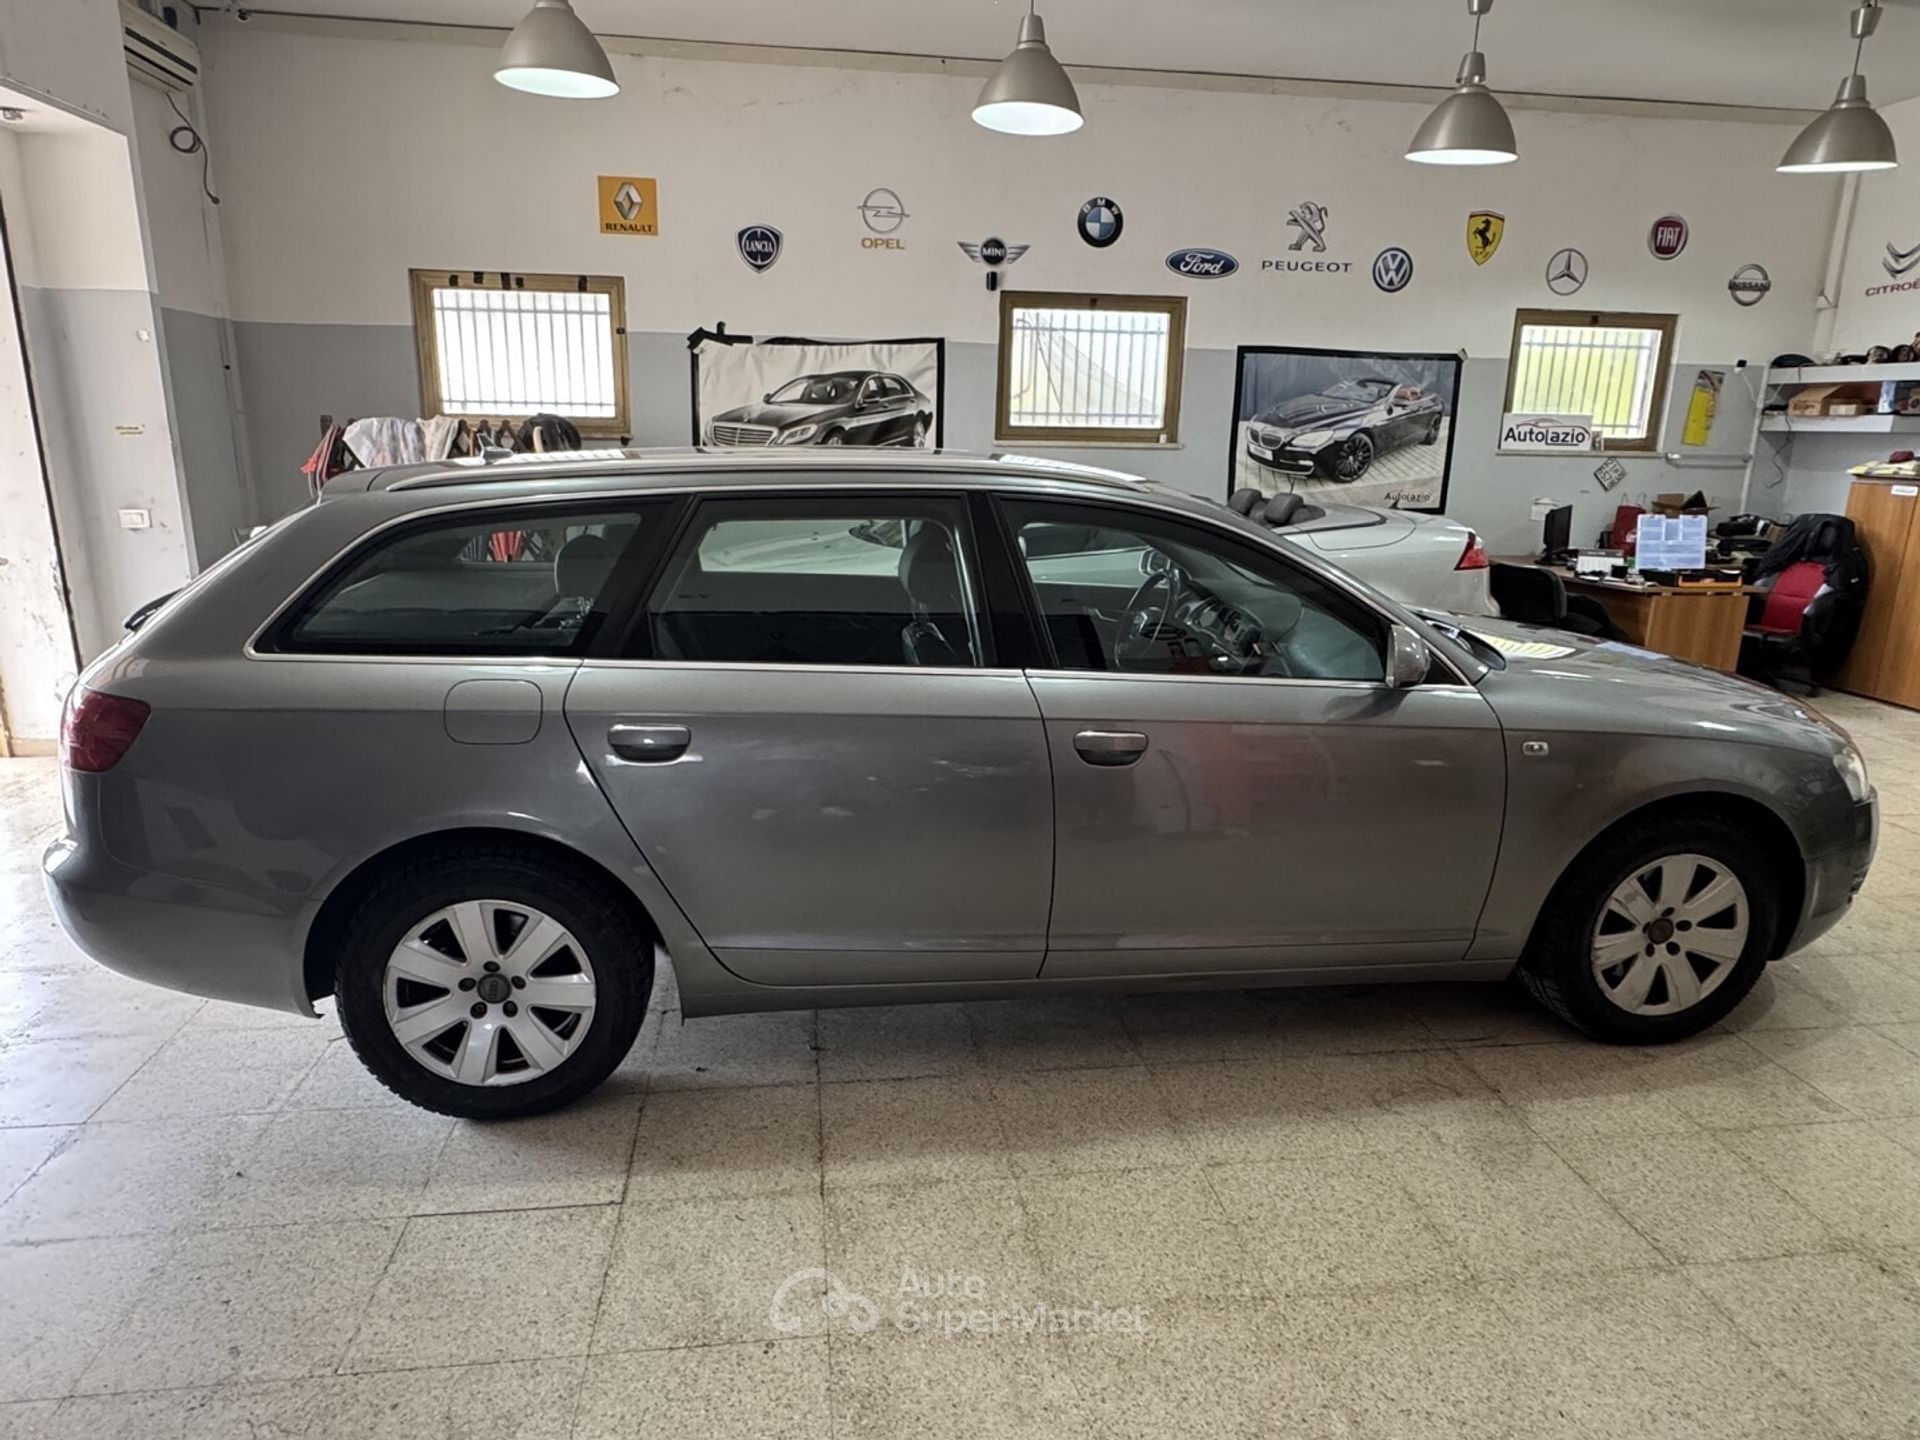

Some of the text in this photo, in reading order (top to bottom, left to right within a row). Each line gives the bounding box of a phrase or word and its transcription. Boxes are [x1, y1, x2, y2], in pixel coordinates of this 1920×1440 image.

[1082, 198, 1120, 216] BMW
[605, 222, 654, 233] RENAULT
[1656, 226, 1682, 248] FIAT
[745, 239, 773, 252] LANCIA
[860, 238, 905, 250] OPEL
[982, 247, 1005, 258] MINI
[1179, 251, 1225, 275] Ford
[1261, 260, 1352, 274] PEUGEOT
